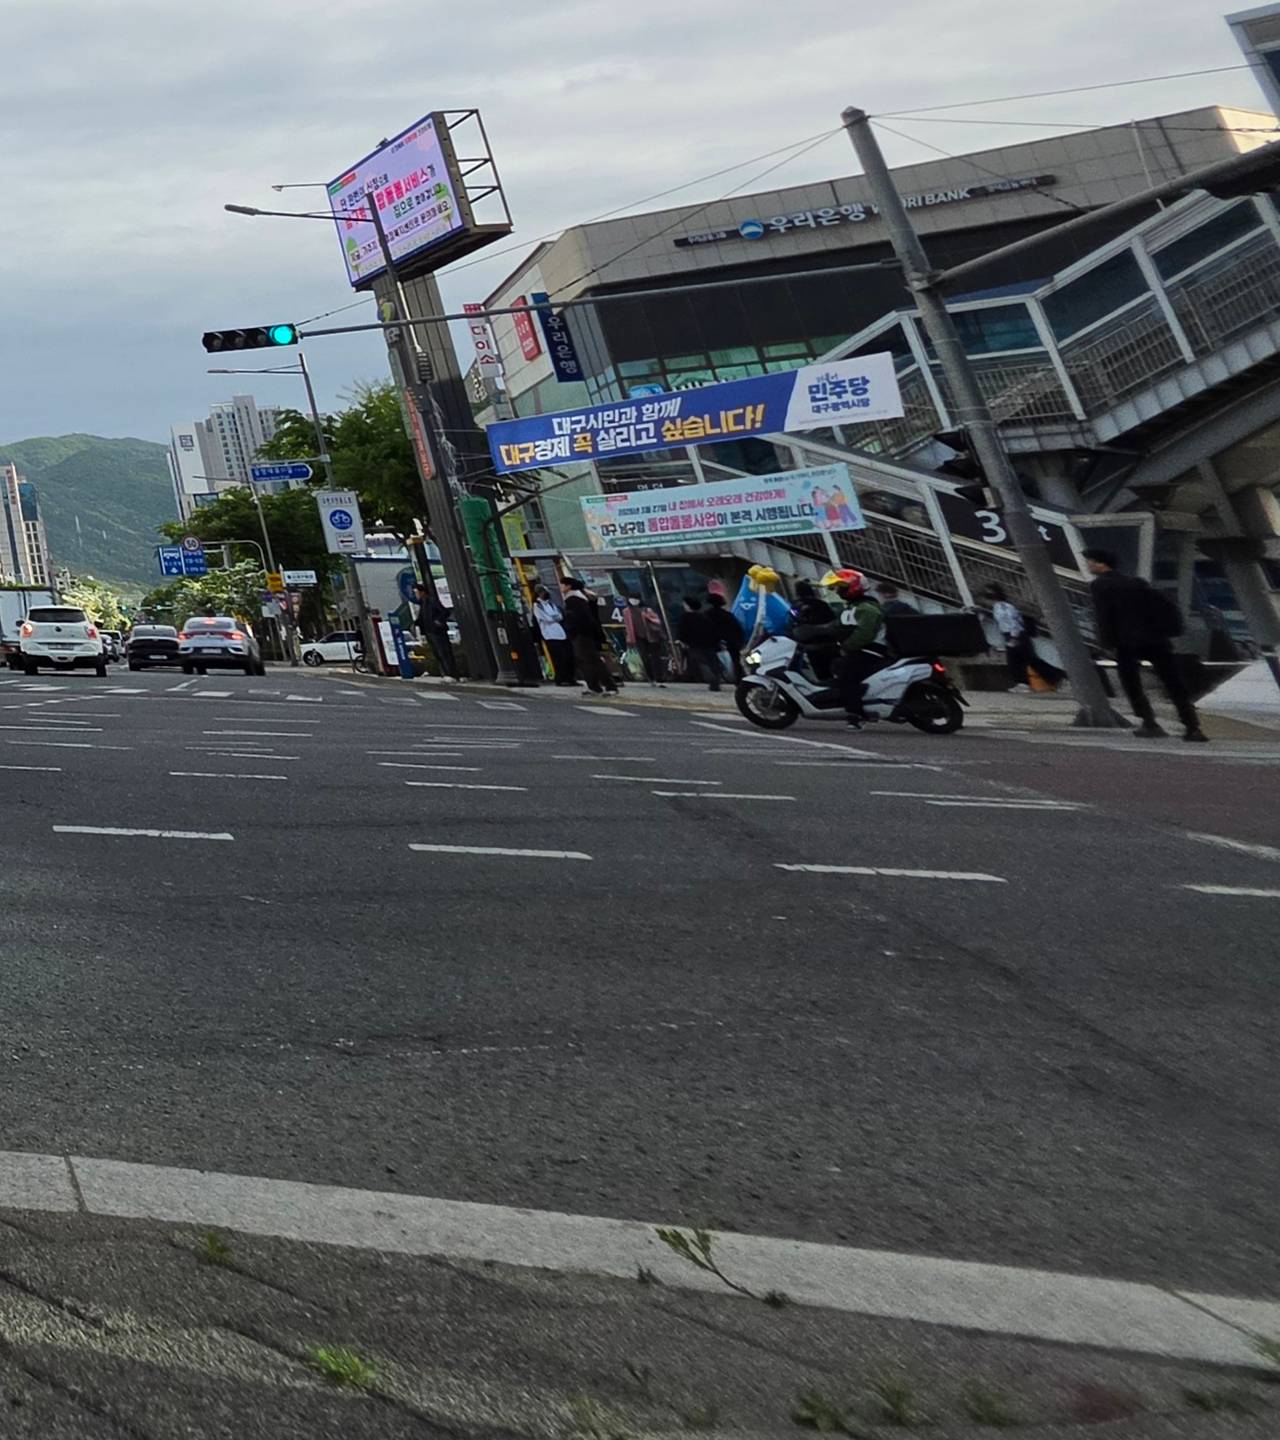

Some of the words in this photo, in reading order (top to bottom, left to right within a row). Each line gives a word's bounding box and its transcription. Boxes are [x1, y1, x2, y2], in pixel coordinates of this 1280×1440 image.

[375, 164, 436, 211] 합돌봄서비스가
[925, 188, 971, 206] BANK
[769, 203, 866, 233] 우리은행
[471, 325, 497, 364] 다이소
[547, 316, 577, 374] 우리은행
[808, 376, 870, 403] 민주당
[552, 406, 637, 435] 대구시민과
[641, 397, 681, 420] 함께
[500, 437, 570, 466] 대구경제
[573, 434, 593, 453] 꼭
[598, 424, 657, 452] 살리고
[661, 404, 765, 442] 싶습니다!
[974, 509, 1006, 543] 3
[611, 607, 623, 622] 4
